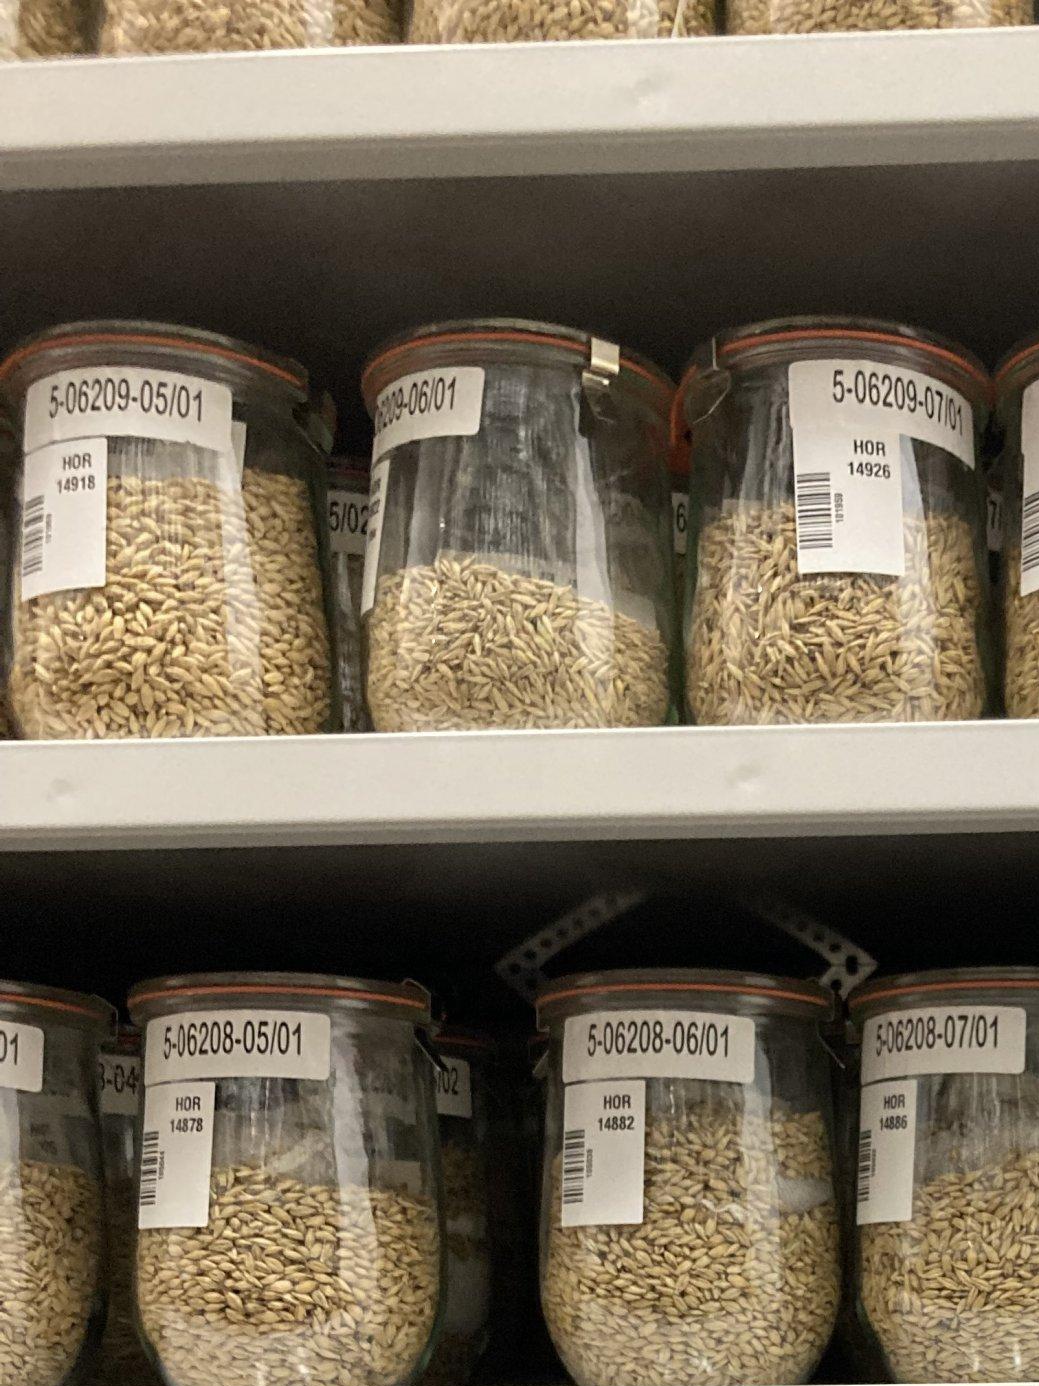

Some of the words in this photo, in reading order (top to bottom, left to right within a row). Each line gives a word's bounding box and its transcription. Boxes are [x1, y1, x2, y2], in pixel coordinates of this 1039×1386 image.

[48, 377, 204, 423] 5-06209-05/01
[832, 369, 965, 436] 5-06209-07/01
[852, 438, 886, 457] HOR
[62, 452, 92, 470] HOR
[847, 461, 892, 480] 14926
[56, 475, 96, 493] 14918
[163, 1020, 303, 1062] 5-06208-05/01
[587, 1020, 731, 1059] 5-06208-06/01
[876, 1013, 1000, 1059] 5-06208-07/01
[175, 1095, 201, 1112] HOR
[602, 1093, 632, 1110] HOR
[883, 1094, 906, 1110] HOR
[169, 1116, 203, 1134] 14878
[597, 1115, 635, 1132] 14882
[879, 1115, 907, 1131] 14886
